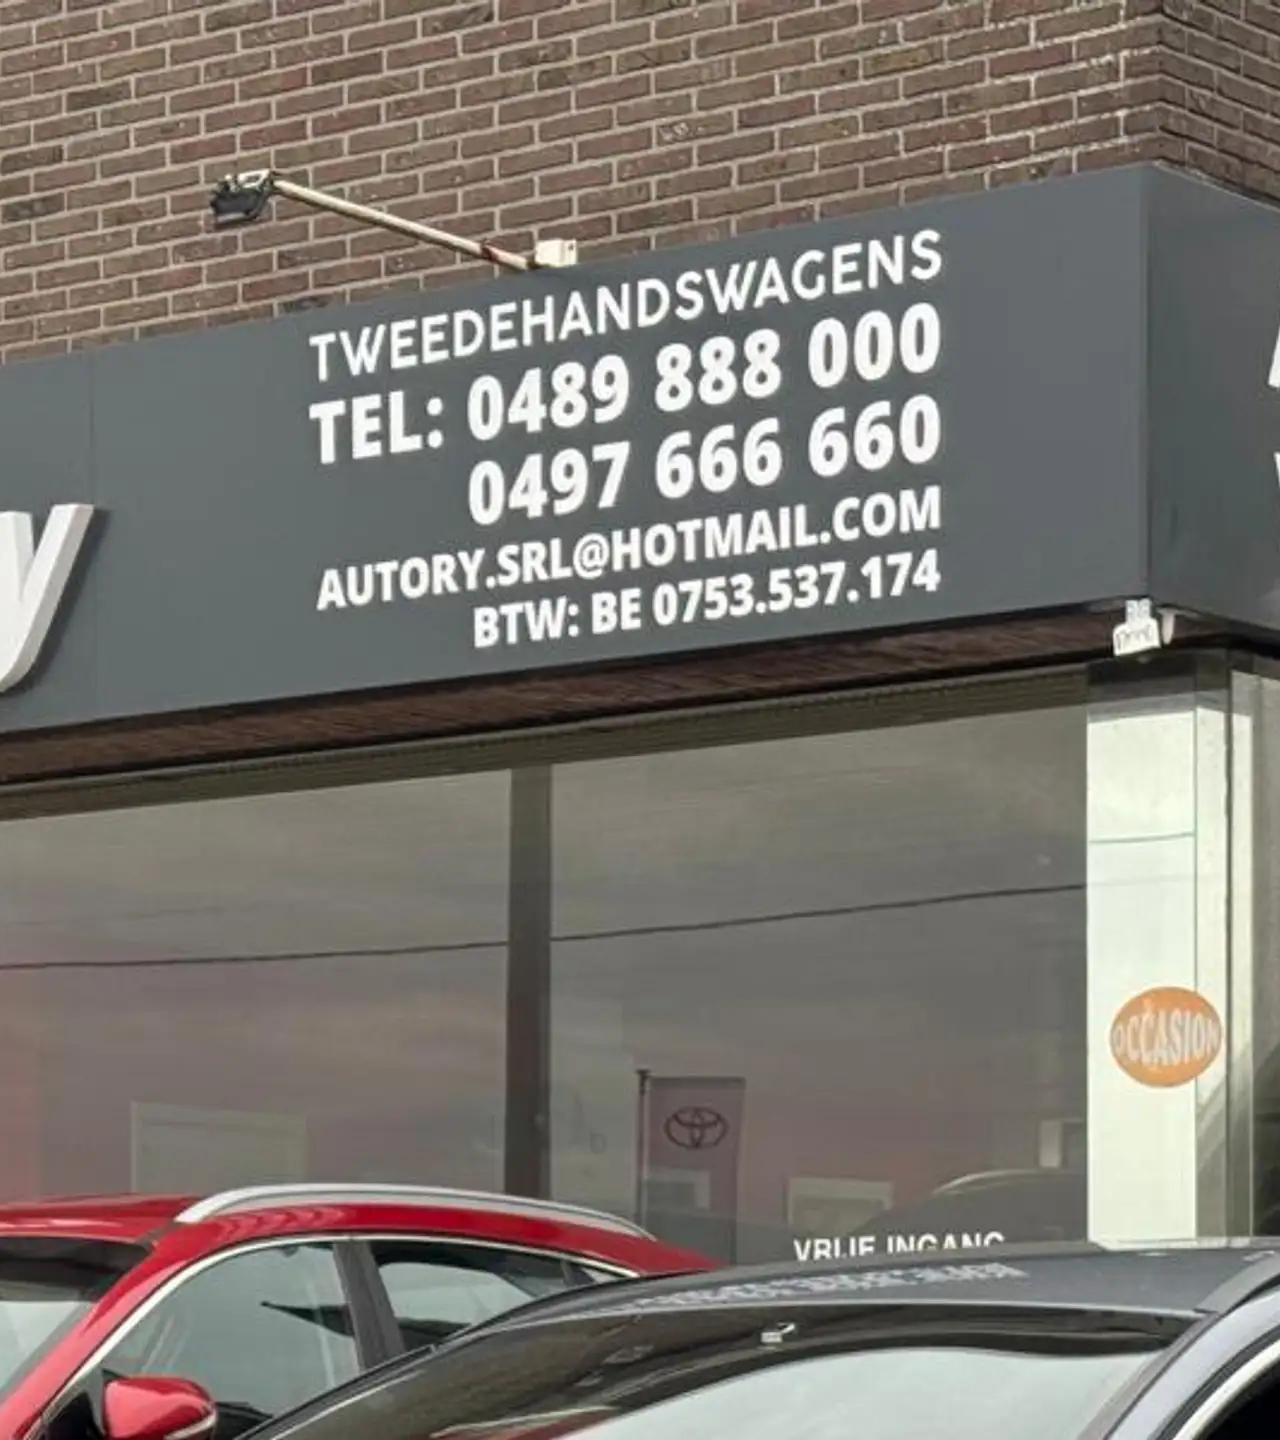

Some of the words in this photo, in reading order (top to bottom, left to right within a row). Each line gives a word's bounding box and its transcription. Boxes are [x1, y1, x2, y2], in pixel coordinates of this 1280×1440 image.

[309, 229, 942, 382] TWEEDEHANDSWAGENS
[309, 391, 443, 464] TEL:
[467, 356, 630, 441] 0489
[655, 328, 781, 412] 888
[809, 302, 941, 387] 000
[468, 441, 630, 525] 0497
[655, 418, 782, 499] 666
[809, 394, 941, 477] 660
[317, 485, 941, 610] AUTORY.SRL@HOTMAIL.COM
[474, 601, 579, 649] BTW:
[592, 588, 640, 634] BE
[654, 549, 940, 626] 0753.537.174
[1112, 1006, 1221, 1067] OCCASION
